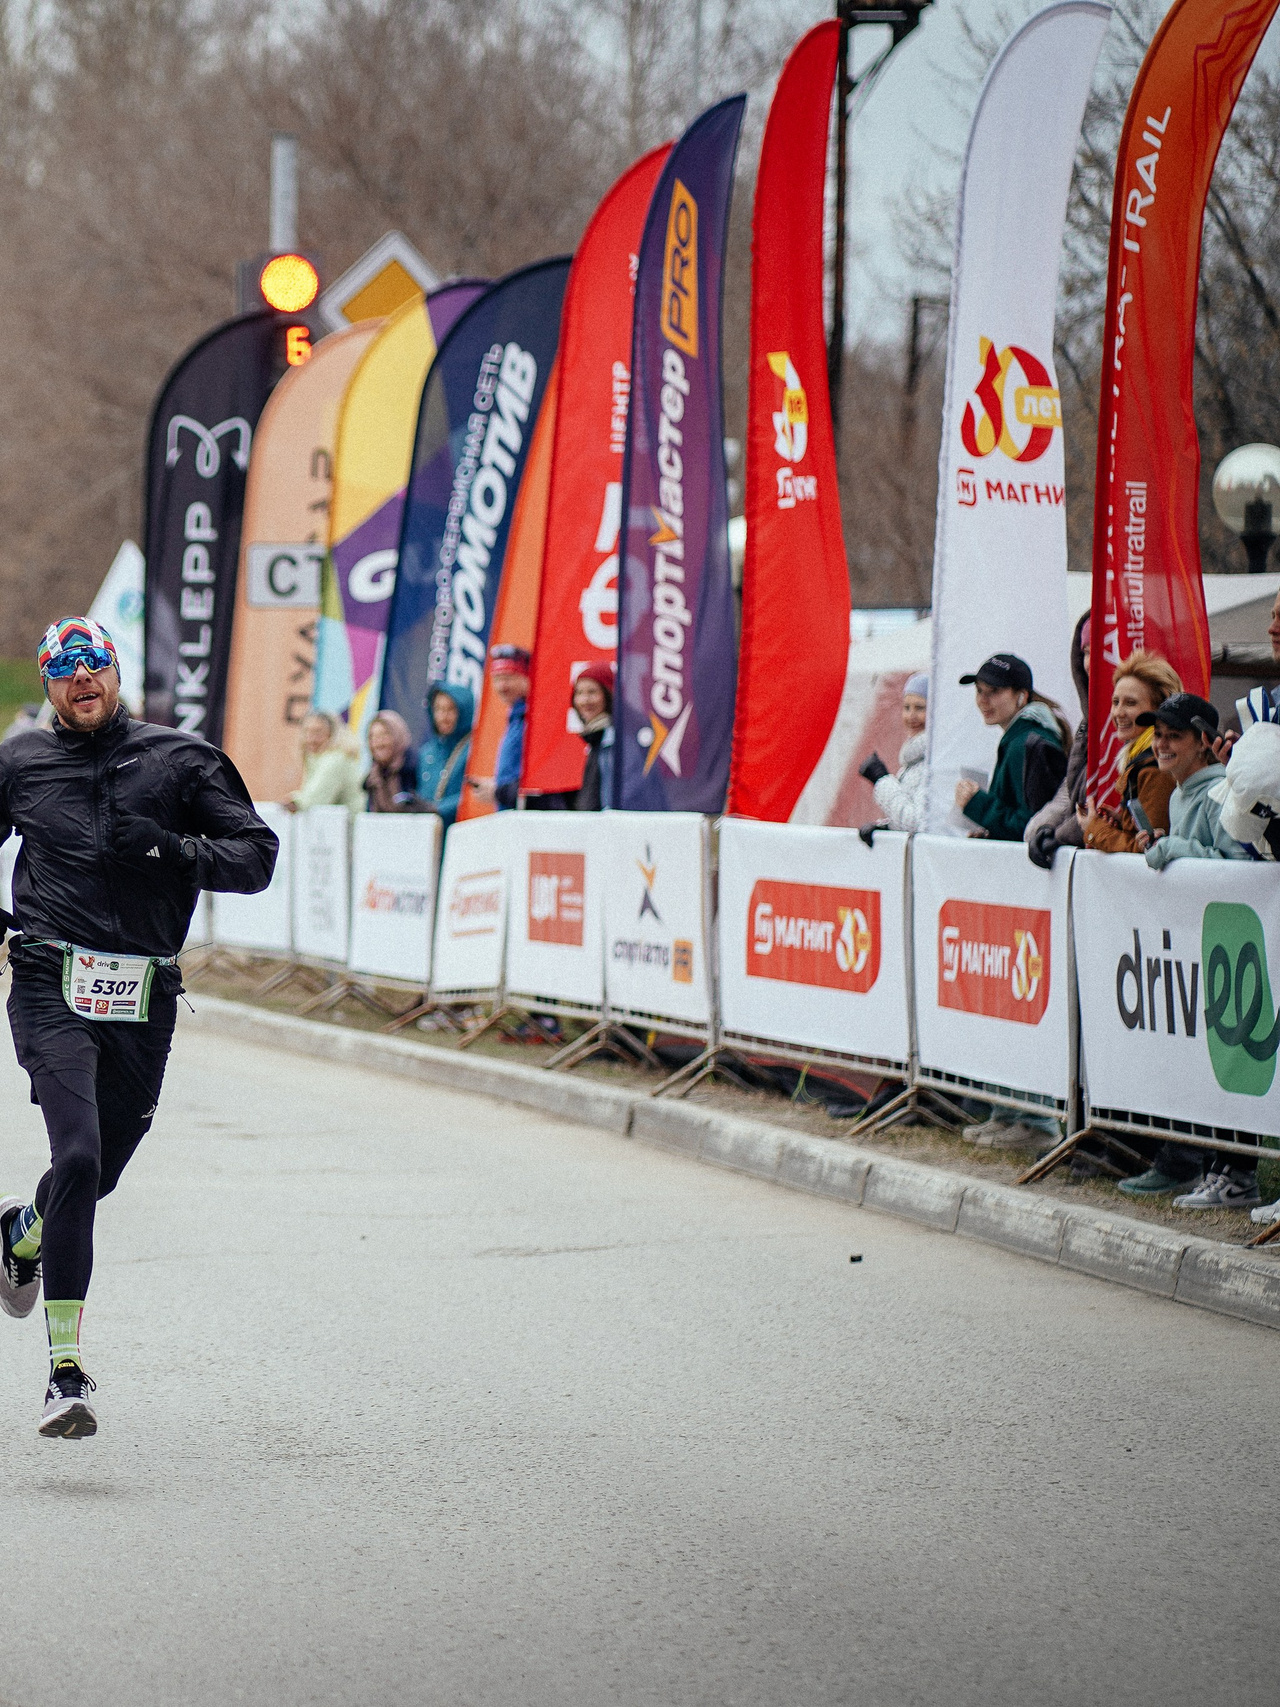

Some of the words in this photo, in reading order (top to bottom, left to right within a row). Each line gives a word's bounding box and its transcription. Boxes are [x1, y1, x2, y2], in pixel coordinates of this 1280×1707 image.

[669, 202, 692, 341] PRO
[473, 342, 504, 413] СЕТЬ
[985, 479, 1065, 508] МАГНИ
[447, 341, 538, 698] ВТОМОТИВ
[774, 915, 835, 954] МАГНИТ
[960, 940, 1011, 981] МАГНИТ
[90, 978, 140, 997] 5307
